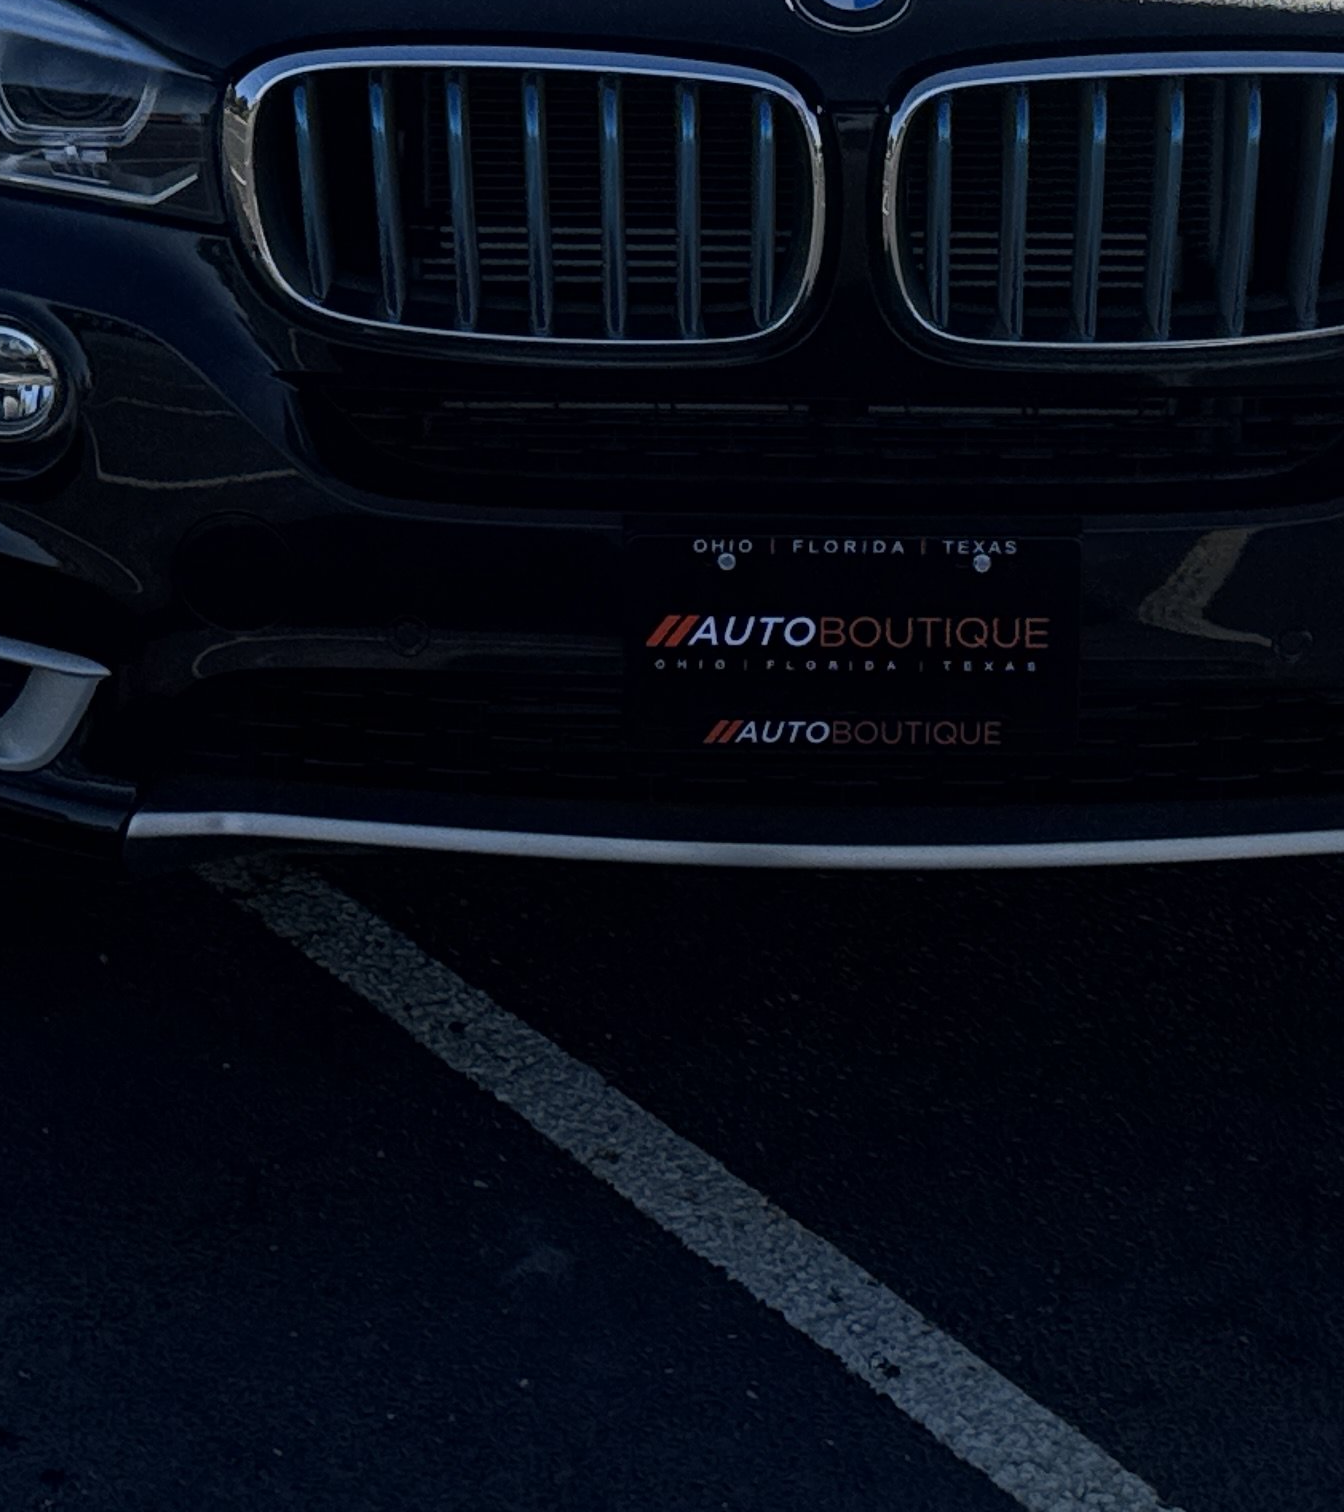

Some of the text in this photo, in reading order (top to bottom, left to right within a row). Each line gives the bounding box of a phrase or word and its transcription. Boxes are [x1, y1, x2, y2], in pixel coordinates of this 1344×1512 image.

[692, 539, 1018, 555] OHIO FLORIDA TEXAS
[687, 615, 1050, 649] AUTOBOUTIQUE
[654, 659, 1037, 672] OHIO FLORIDA TEXAS
[735, 720, 1002, 745] AUTOBOUTIQUE
